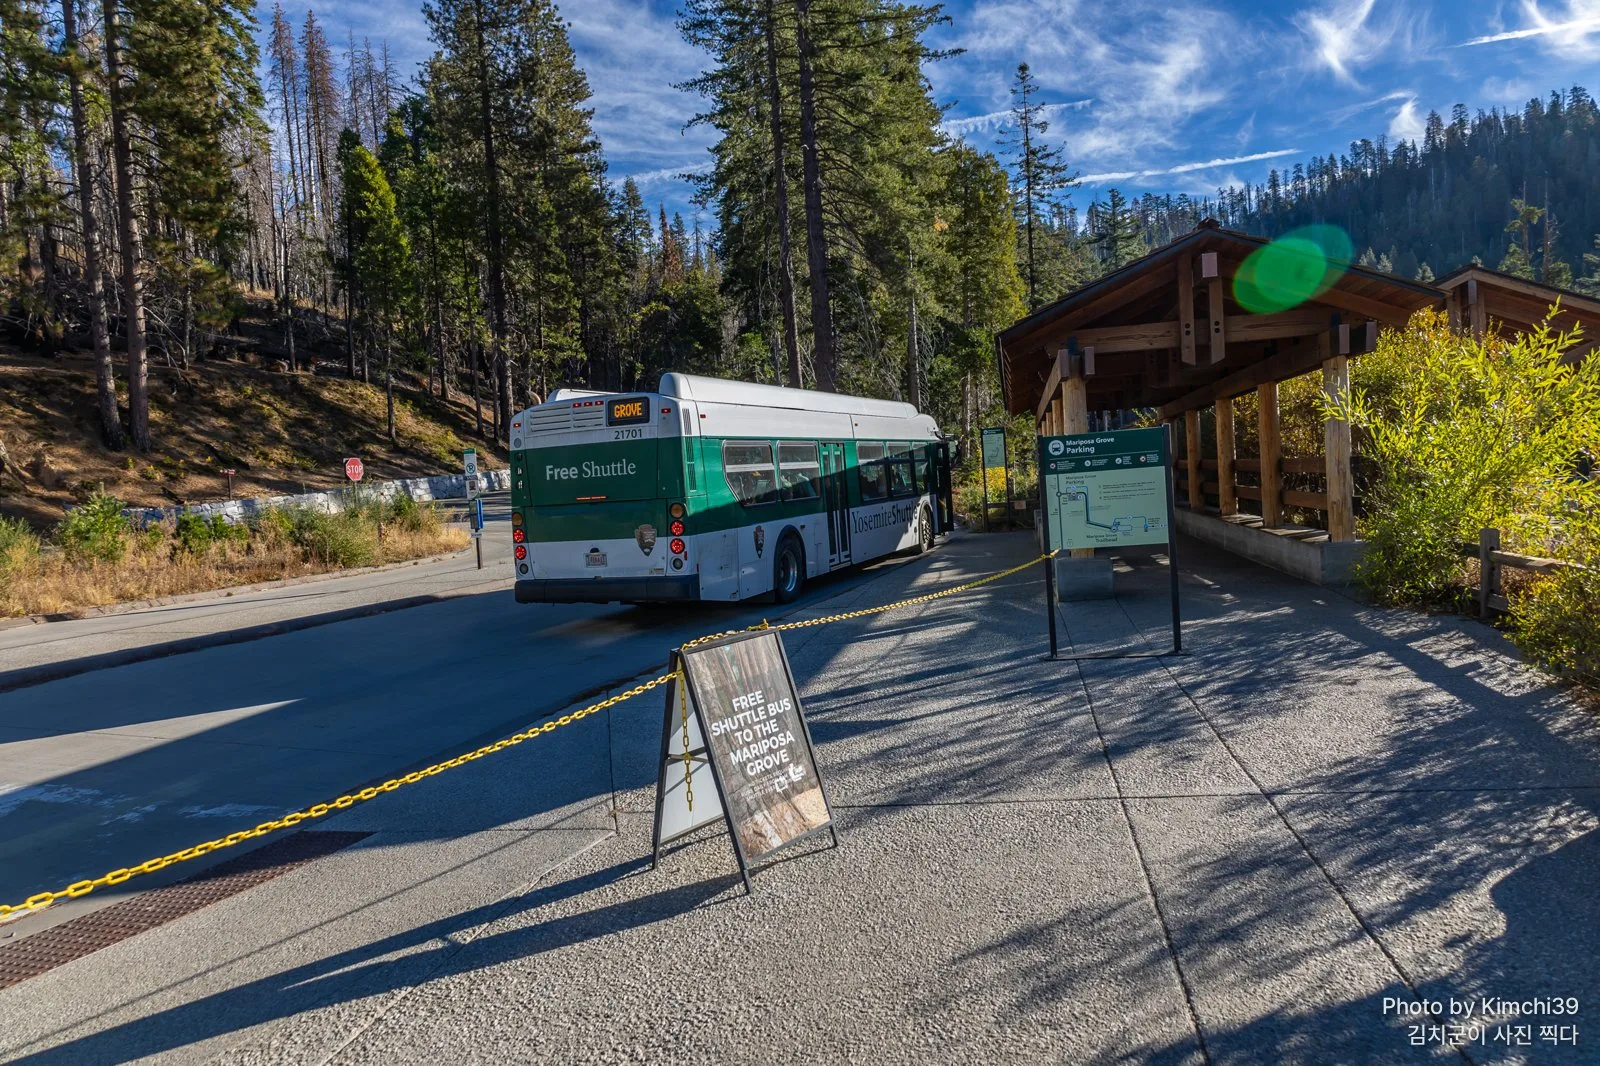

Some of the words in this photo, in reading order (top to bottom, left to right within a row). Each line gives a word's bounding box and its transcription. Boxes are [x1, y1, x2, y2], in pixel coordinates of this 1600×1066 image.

[613, 401, 643, 418] GROVE
[614, 428, 643, 440] 21701
[1066, 446, 1095, 454] Parking
[346, 465, 364, 474] STOP
[545, 464, 579, 481] Free
[582, 458, 636, 479] Shuttle
[851, 501, 918, 534] YosemiteShuttle
[731, 690, 765, 712] FREE
[711, 707, 767, 736] SHUTTLE
[767, 698, 791, 717] BUS
[734, 728, 753, 745] TO
[753, 718, 779, 738] THE
[729, 730, 795, 766] MARIPOSA
[746, 748, 790, 776] GROVE
